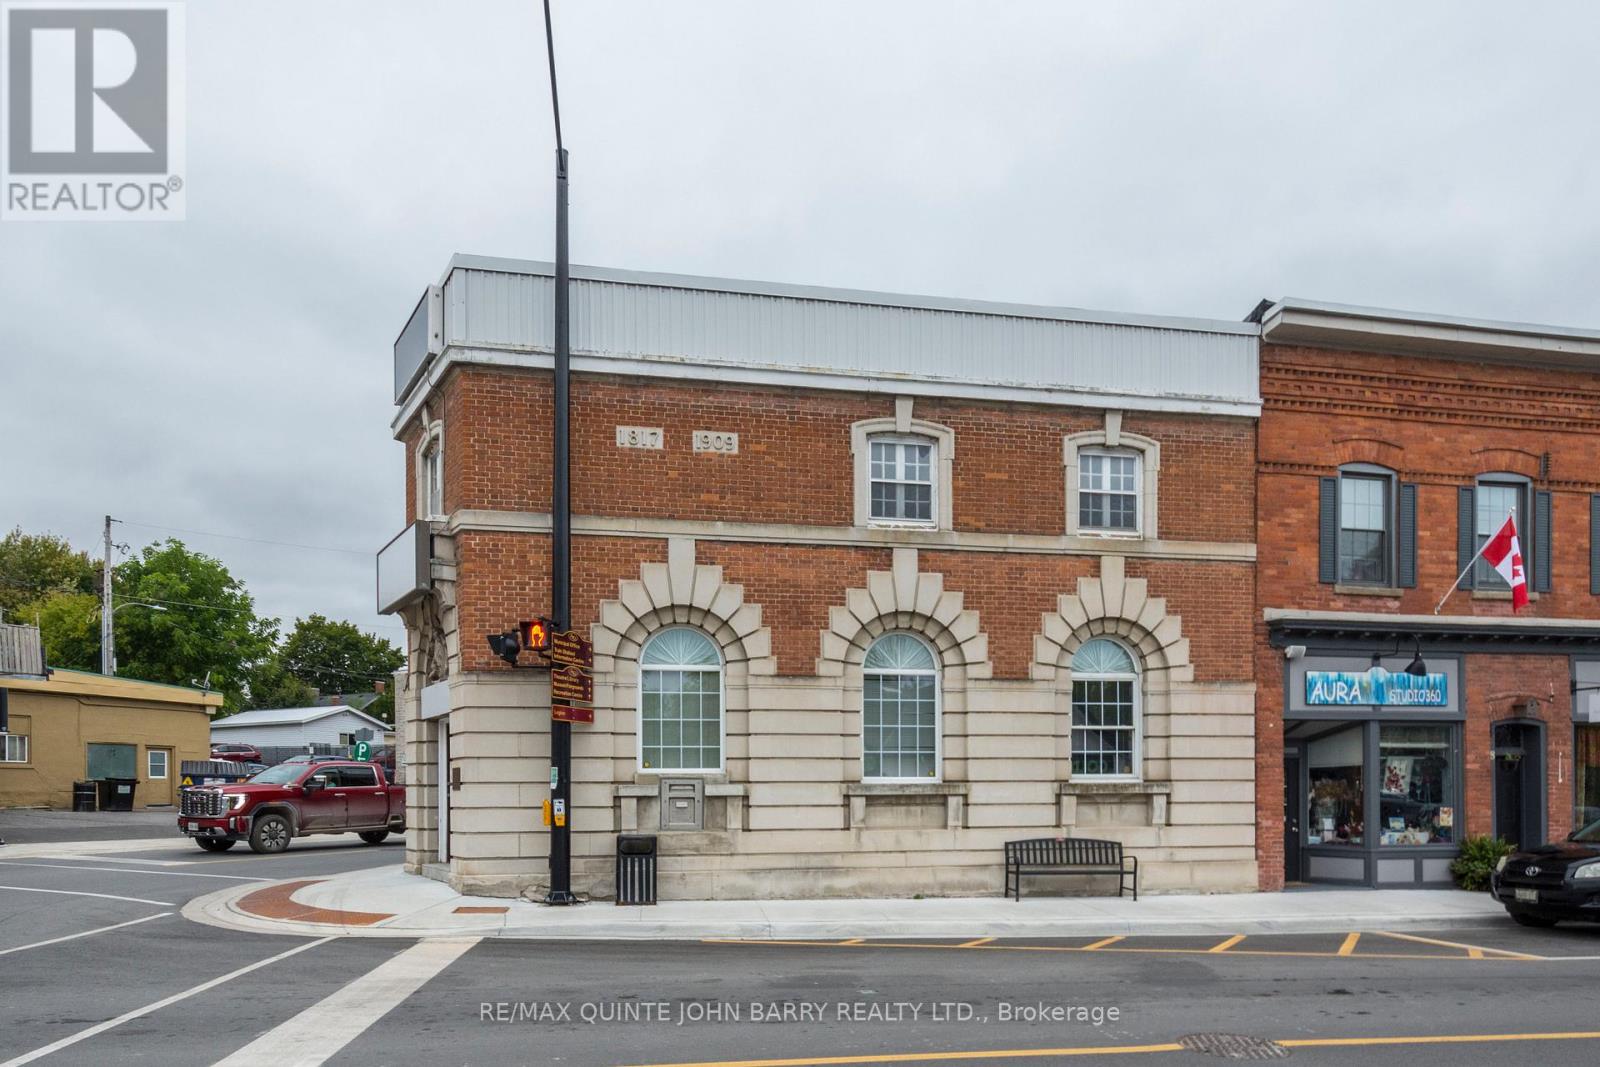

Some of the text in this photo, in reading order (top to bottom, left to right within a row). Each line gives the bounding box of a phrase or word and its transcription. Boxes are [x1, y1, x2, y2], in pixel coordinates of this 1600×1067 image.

[619, 429, 660, 447] 1817
[695, 433, 733, 452] 1909
[1309, 680, 1361, 704] AURA
[359, 743, 367, 756] P
